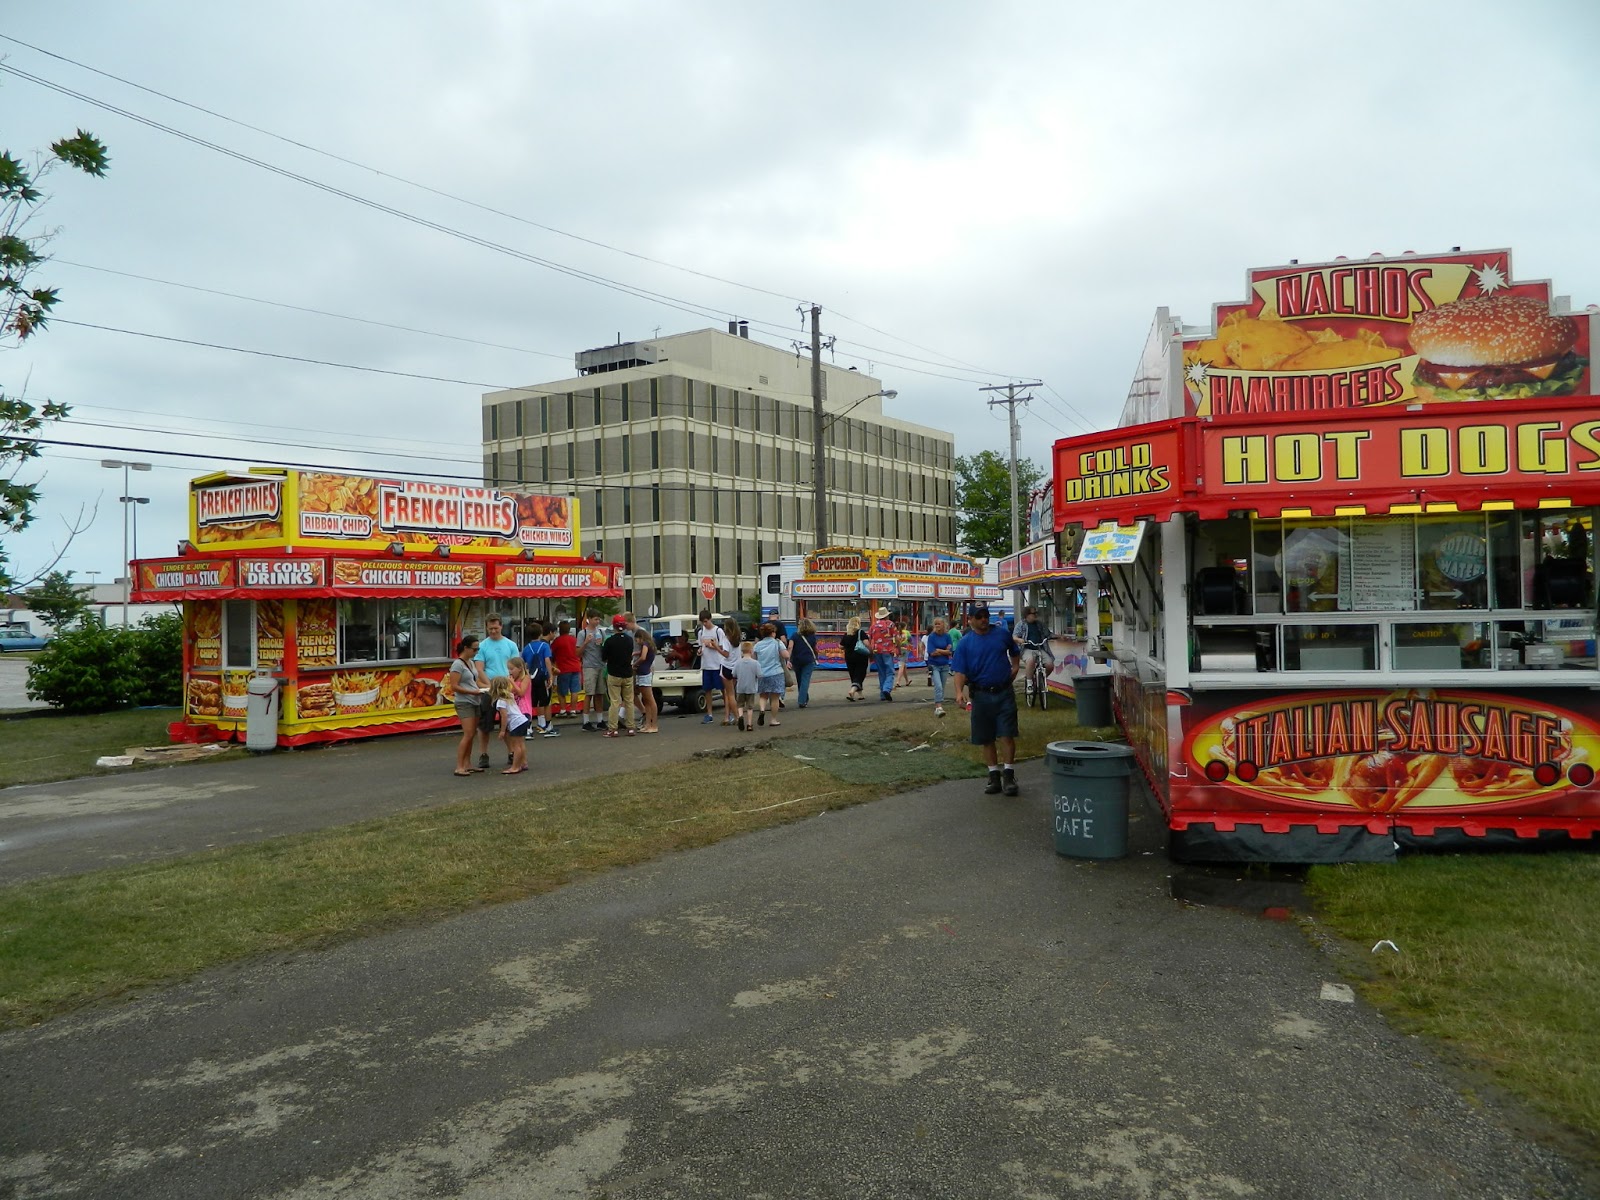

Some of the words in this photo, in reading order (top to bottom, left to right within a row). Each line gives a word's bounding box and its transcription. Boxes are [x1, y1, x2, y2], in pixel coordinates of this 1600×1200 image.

[1276, 267, 1437, 321] NACHOS
[1209, 363, 1404, 415] HAMBURGERS
[1079, 442, 1152, 477] COLD
[1222, 429, 1371, 485] HOT
[1399, 419, 1600, 479] DOGS
[1065, 465, 1171, 504] DRINKS
[201, 487, 242, 518] FRENCH
[244, 482, 277, 513] FRIES
[383, 491, 459, 528] FRENCH
[463, 499, 513, 532] FRIES
[304, 515, 339, 531] RIBBON
[342, 516, 368, 532] CHIPS
[521, 529, 548, 544] CHICKEN
[549, 530, 570, 543] WINGS
[1439, 535, 1486, 557] BOTTLED
[162, 564, 185, 572] TENDER
[249, 562, 269, 573] ICE
[272, 562, 312, 573] COLD
[361, 561, 402, 569] DELICIOUS
[404, 563, 431, 571] CRISPY
[817, 556, 859, 571] POPCORN
[1440, 560, 1481, 578] WATER
[155, 572, 184, 588] CHICKEN
[185, 574, 193, 585] ON
[193, 574, 199, 584] A
[199, 570, 220, 586] STICK
[247, 572, 314, 585] DRINKS
[361, 569, 411, 585] CHICKEN
[415, 570, 462, 586] TENDERS
[515, 573, 559, 587] RIBBON
[561, 573, 591, 587] CHIPS
[701, 582, 714, 593] STOP
[802, 584, 825, 593] COTTON
[827, 584, 849, 593] CANDY
[197, 638, 220, 648] RIBBON
[259, 638, 284, 649] CHICKE
[297, 634, 336, 646] FRENCH
[199, 649, 218, 659] CHIPS
[258, 650, 284, 660] TENDER
[297, 645, 336, 657] FRIES
[1235, 700, 1379, 770] ITALIAN
[1384, 700, 1562, 768] SAUSAGE
[1055, 815, 1094, 839] CAFE
